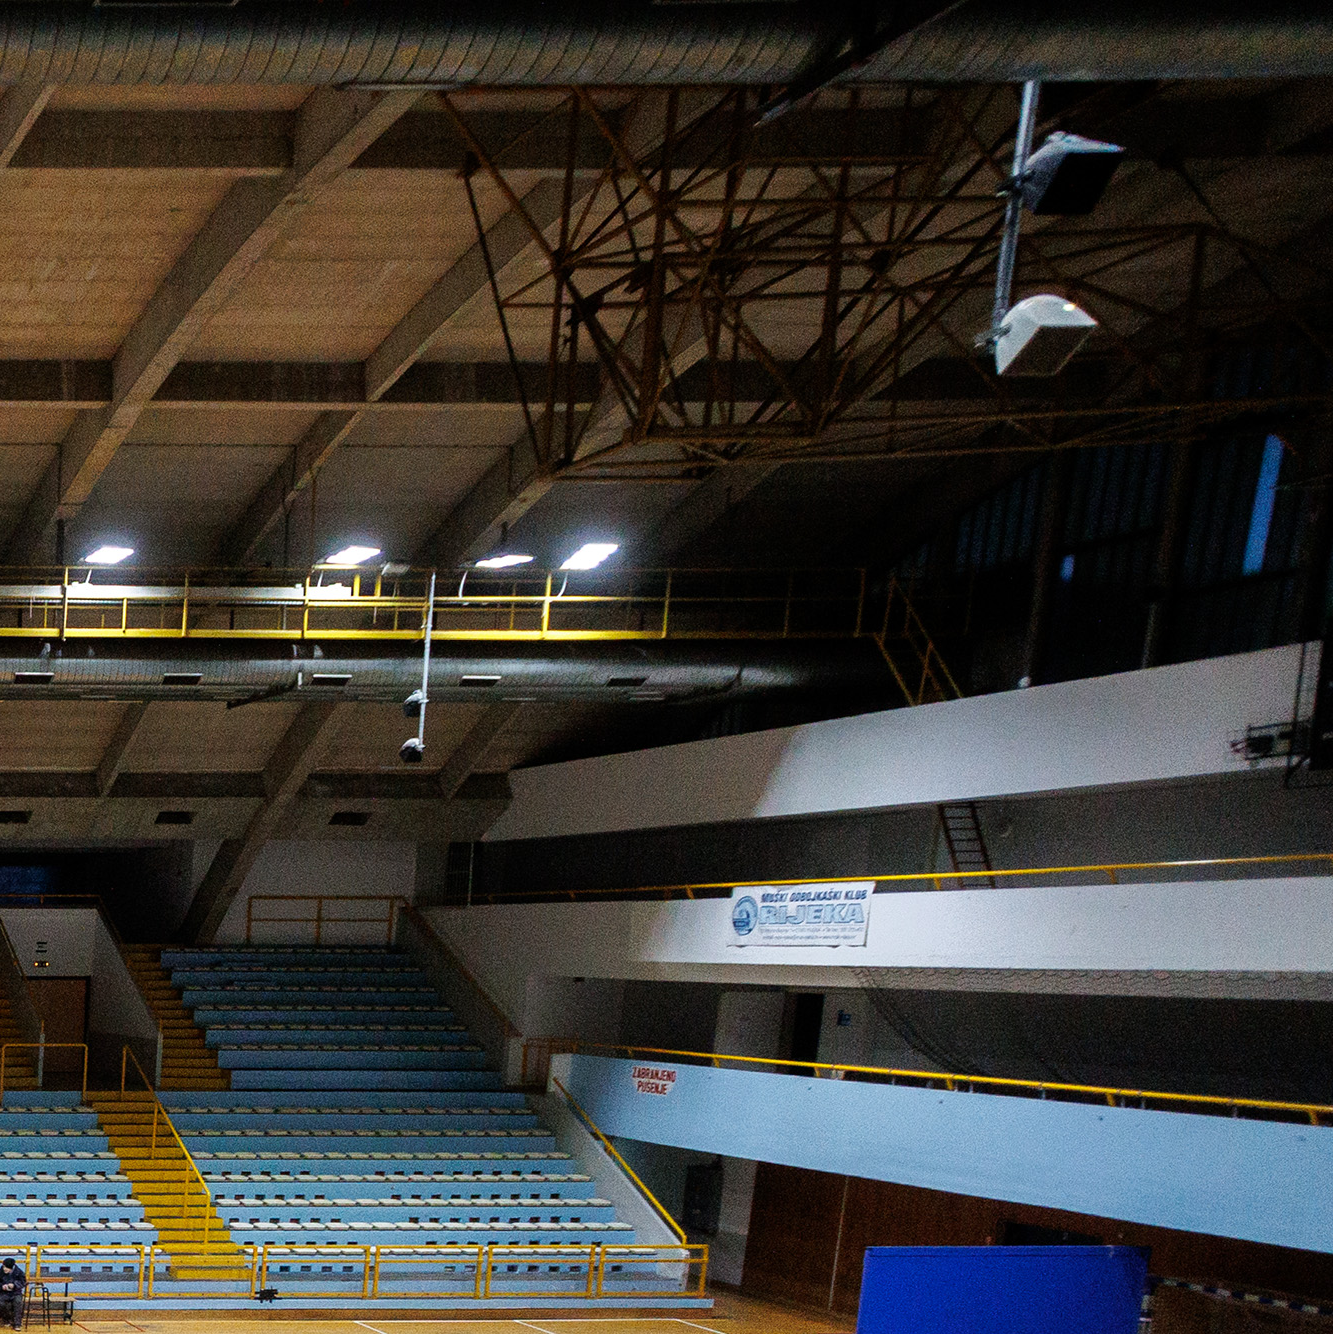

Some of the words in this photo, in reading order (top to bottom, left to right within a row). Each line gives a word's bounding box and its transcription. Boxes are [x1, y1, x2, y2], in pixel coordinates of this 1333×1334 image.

[761, 891, 788, 902] MUŠKI
[789, 888, 843, 902] ODBOJKAŠKI
[844, 889, 868, 900] KLUB
[758, 903, 865, 925] RIJEKA
